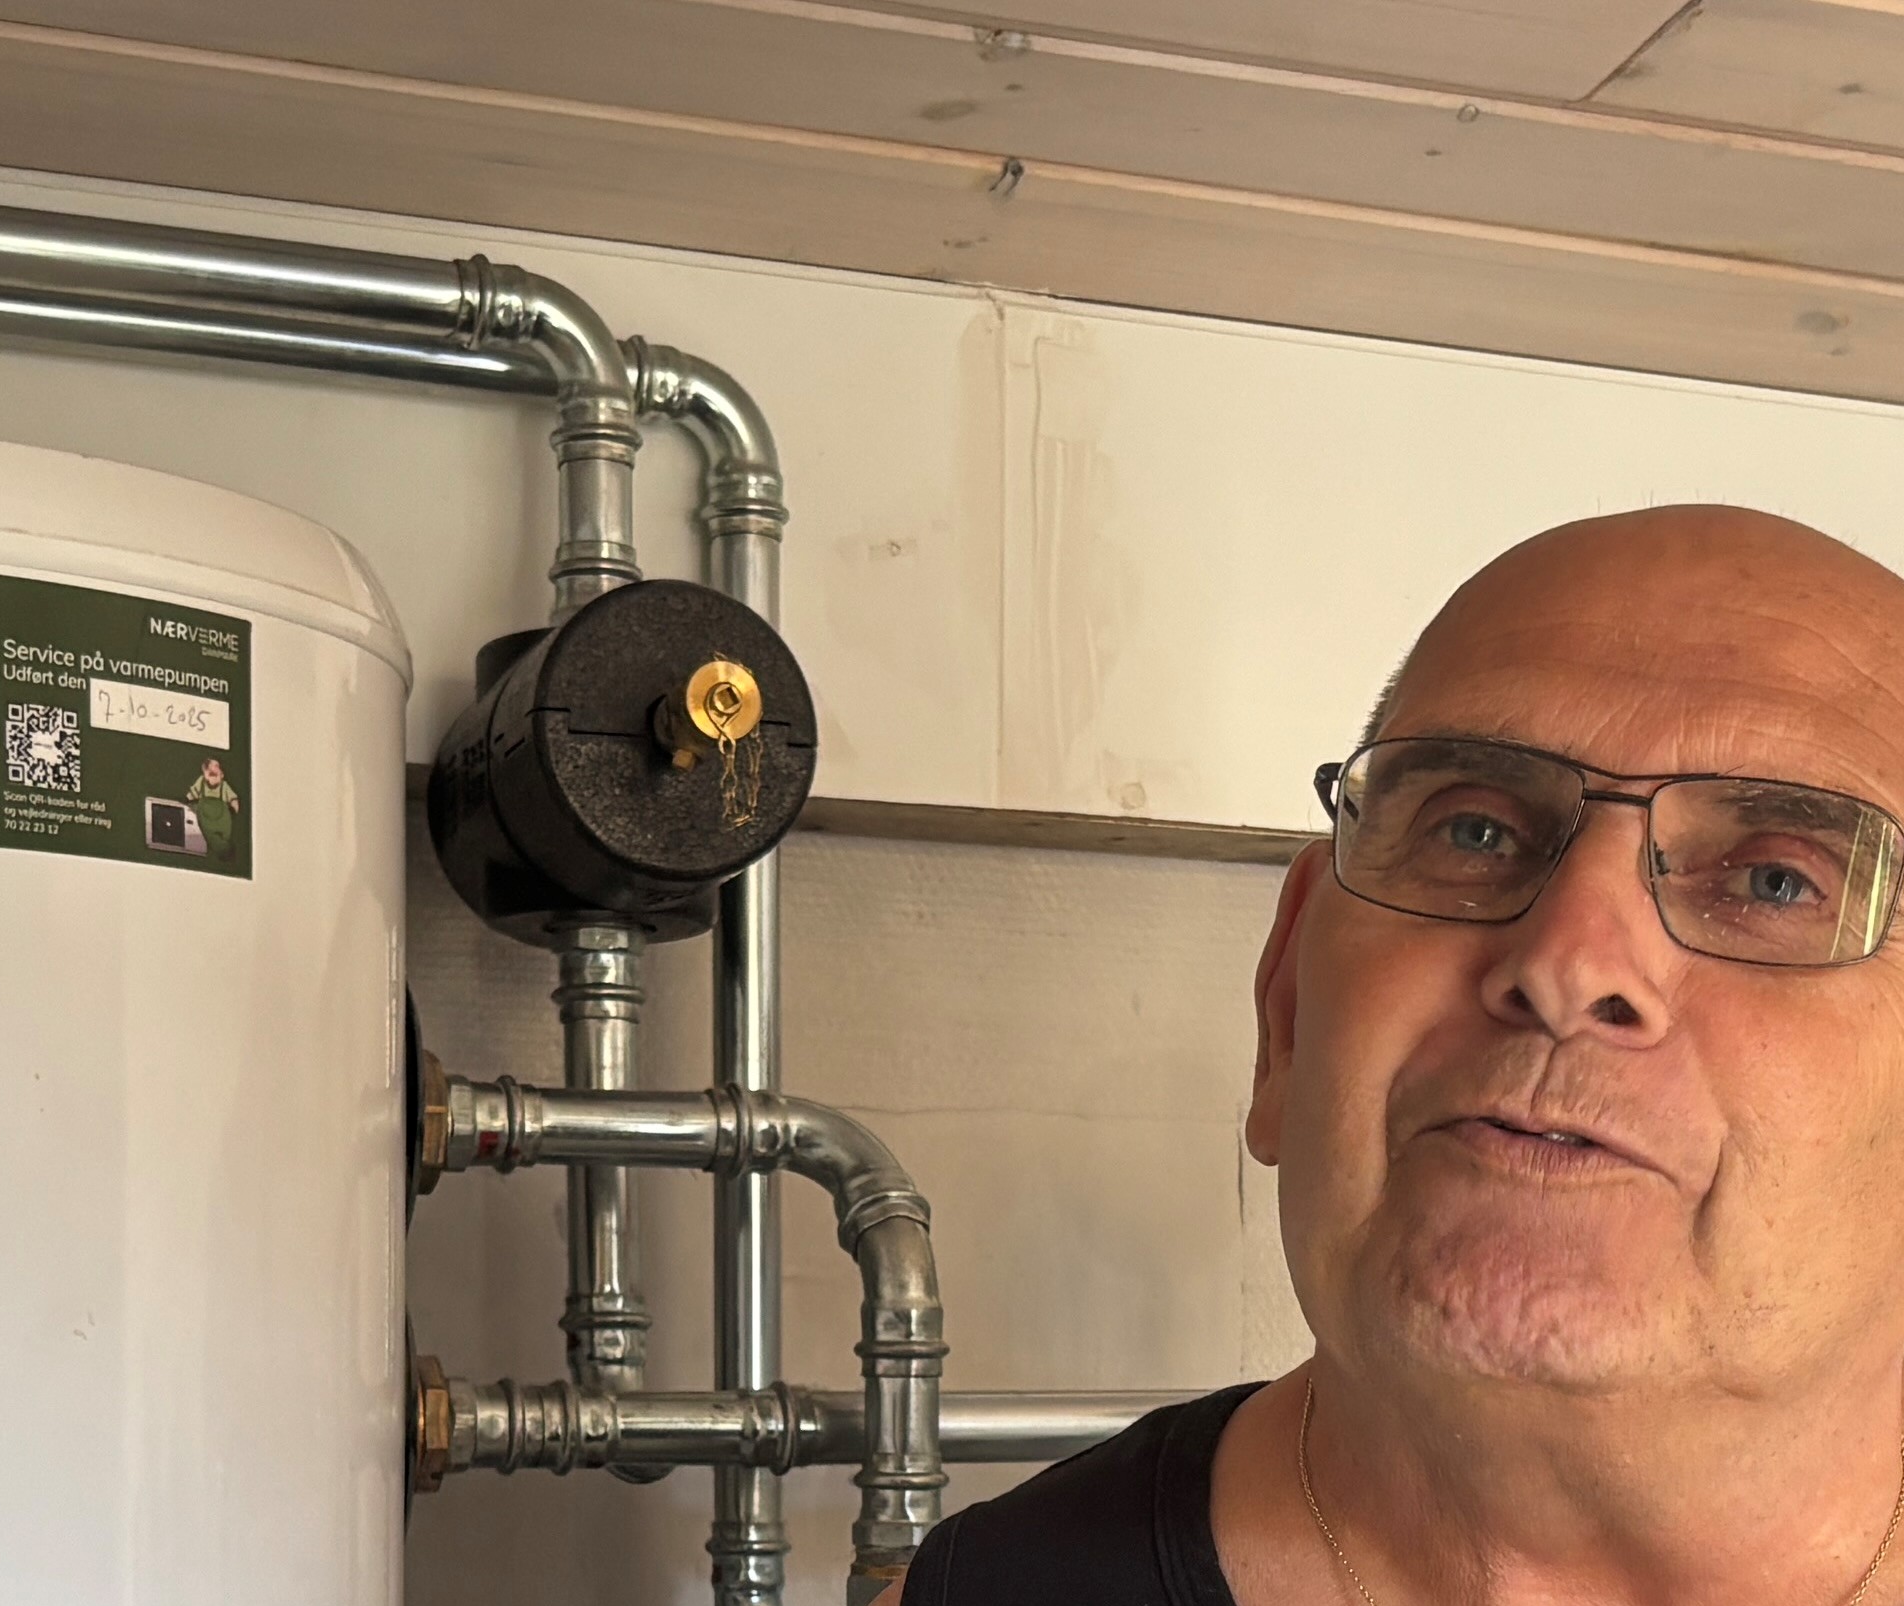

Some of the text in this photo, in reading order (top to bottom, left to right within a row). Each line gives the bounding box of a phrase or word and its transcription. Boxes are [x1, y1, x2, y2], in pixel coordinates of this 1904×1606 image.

[3, 639, 229, 694] Service på varmepumpen
[3, 664, 86, 690] Udført den
[4, 819, 17, 830] 70
[18, 820, 31, 831] 22
